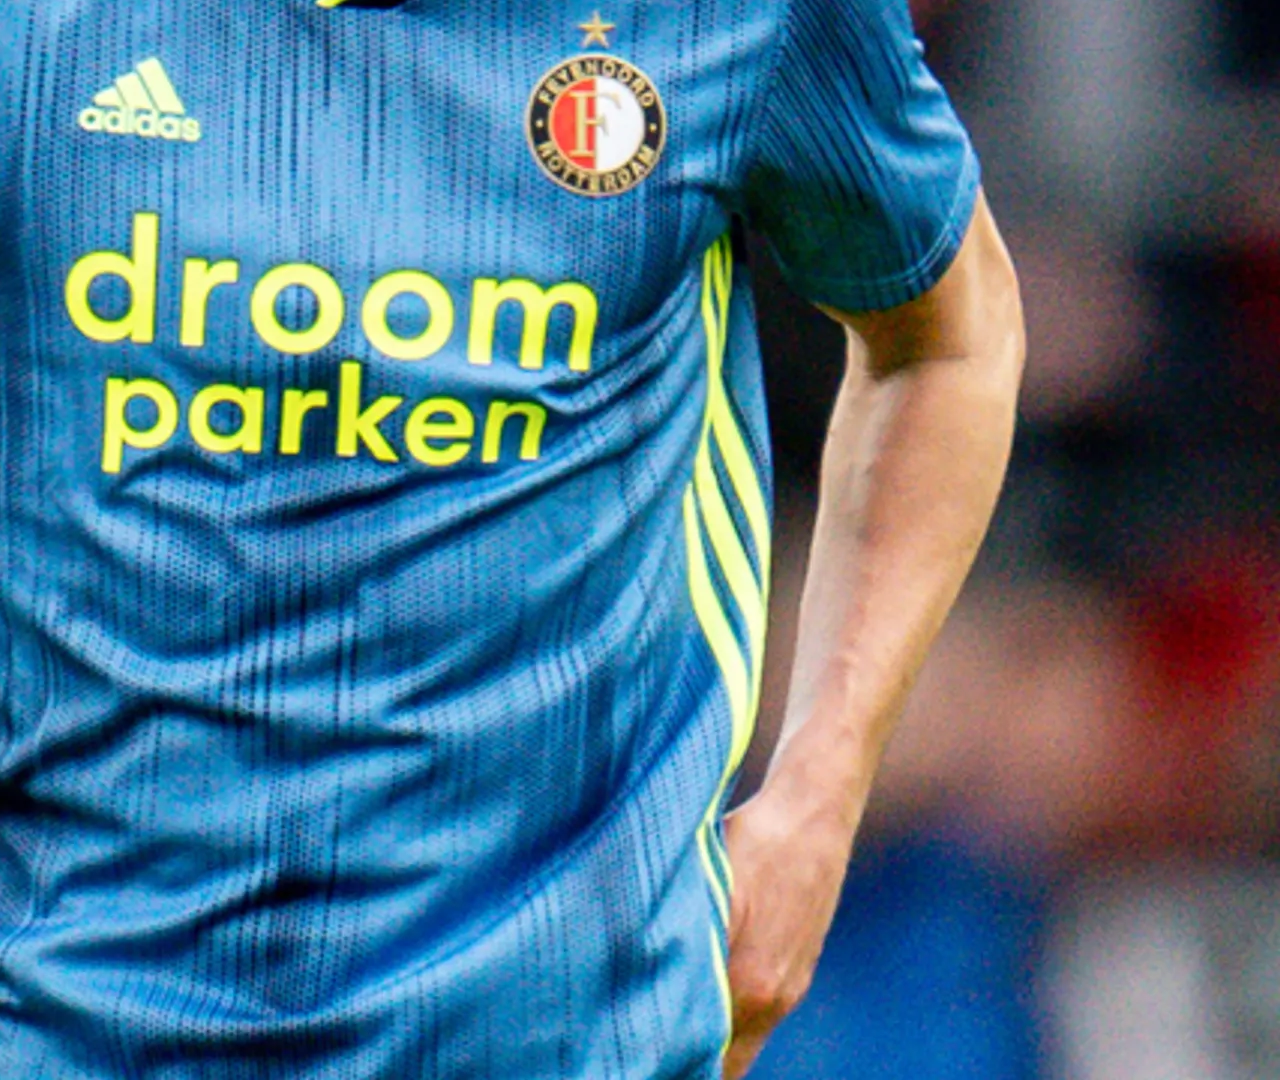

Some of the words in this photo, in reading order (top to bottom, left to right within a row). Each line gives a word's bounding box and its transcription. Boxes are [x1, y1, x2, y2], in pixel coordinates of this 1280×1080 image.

[77, 101, 202, 142] adidas
[64, 212, 599, 372] droom
[100, 360, 547, 473] parken
